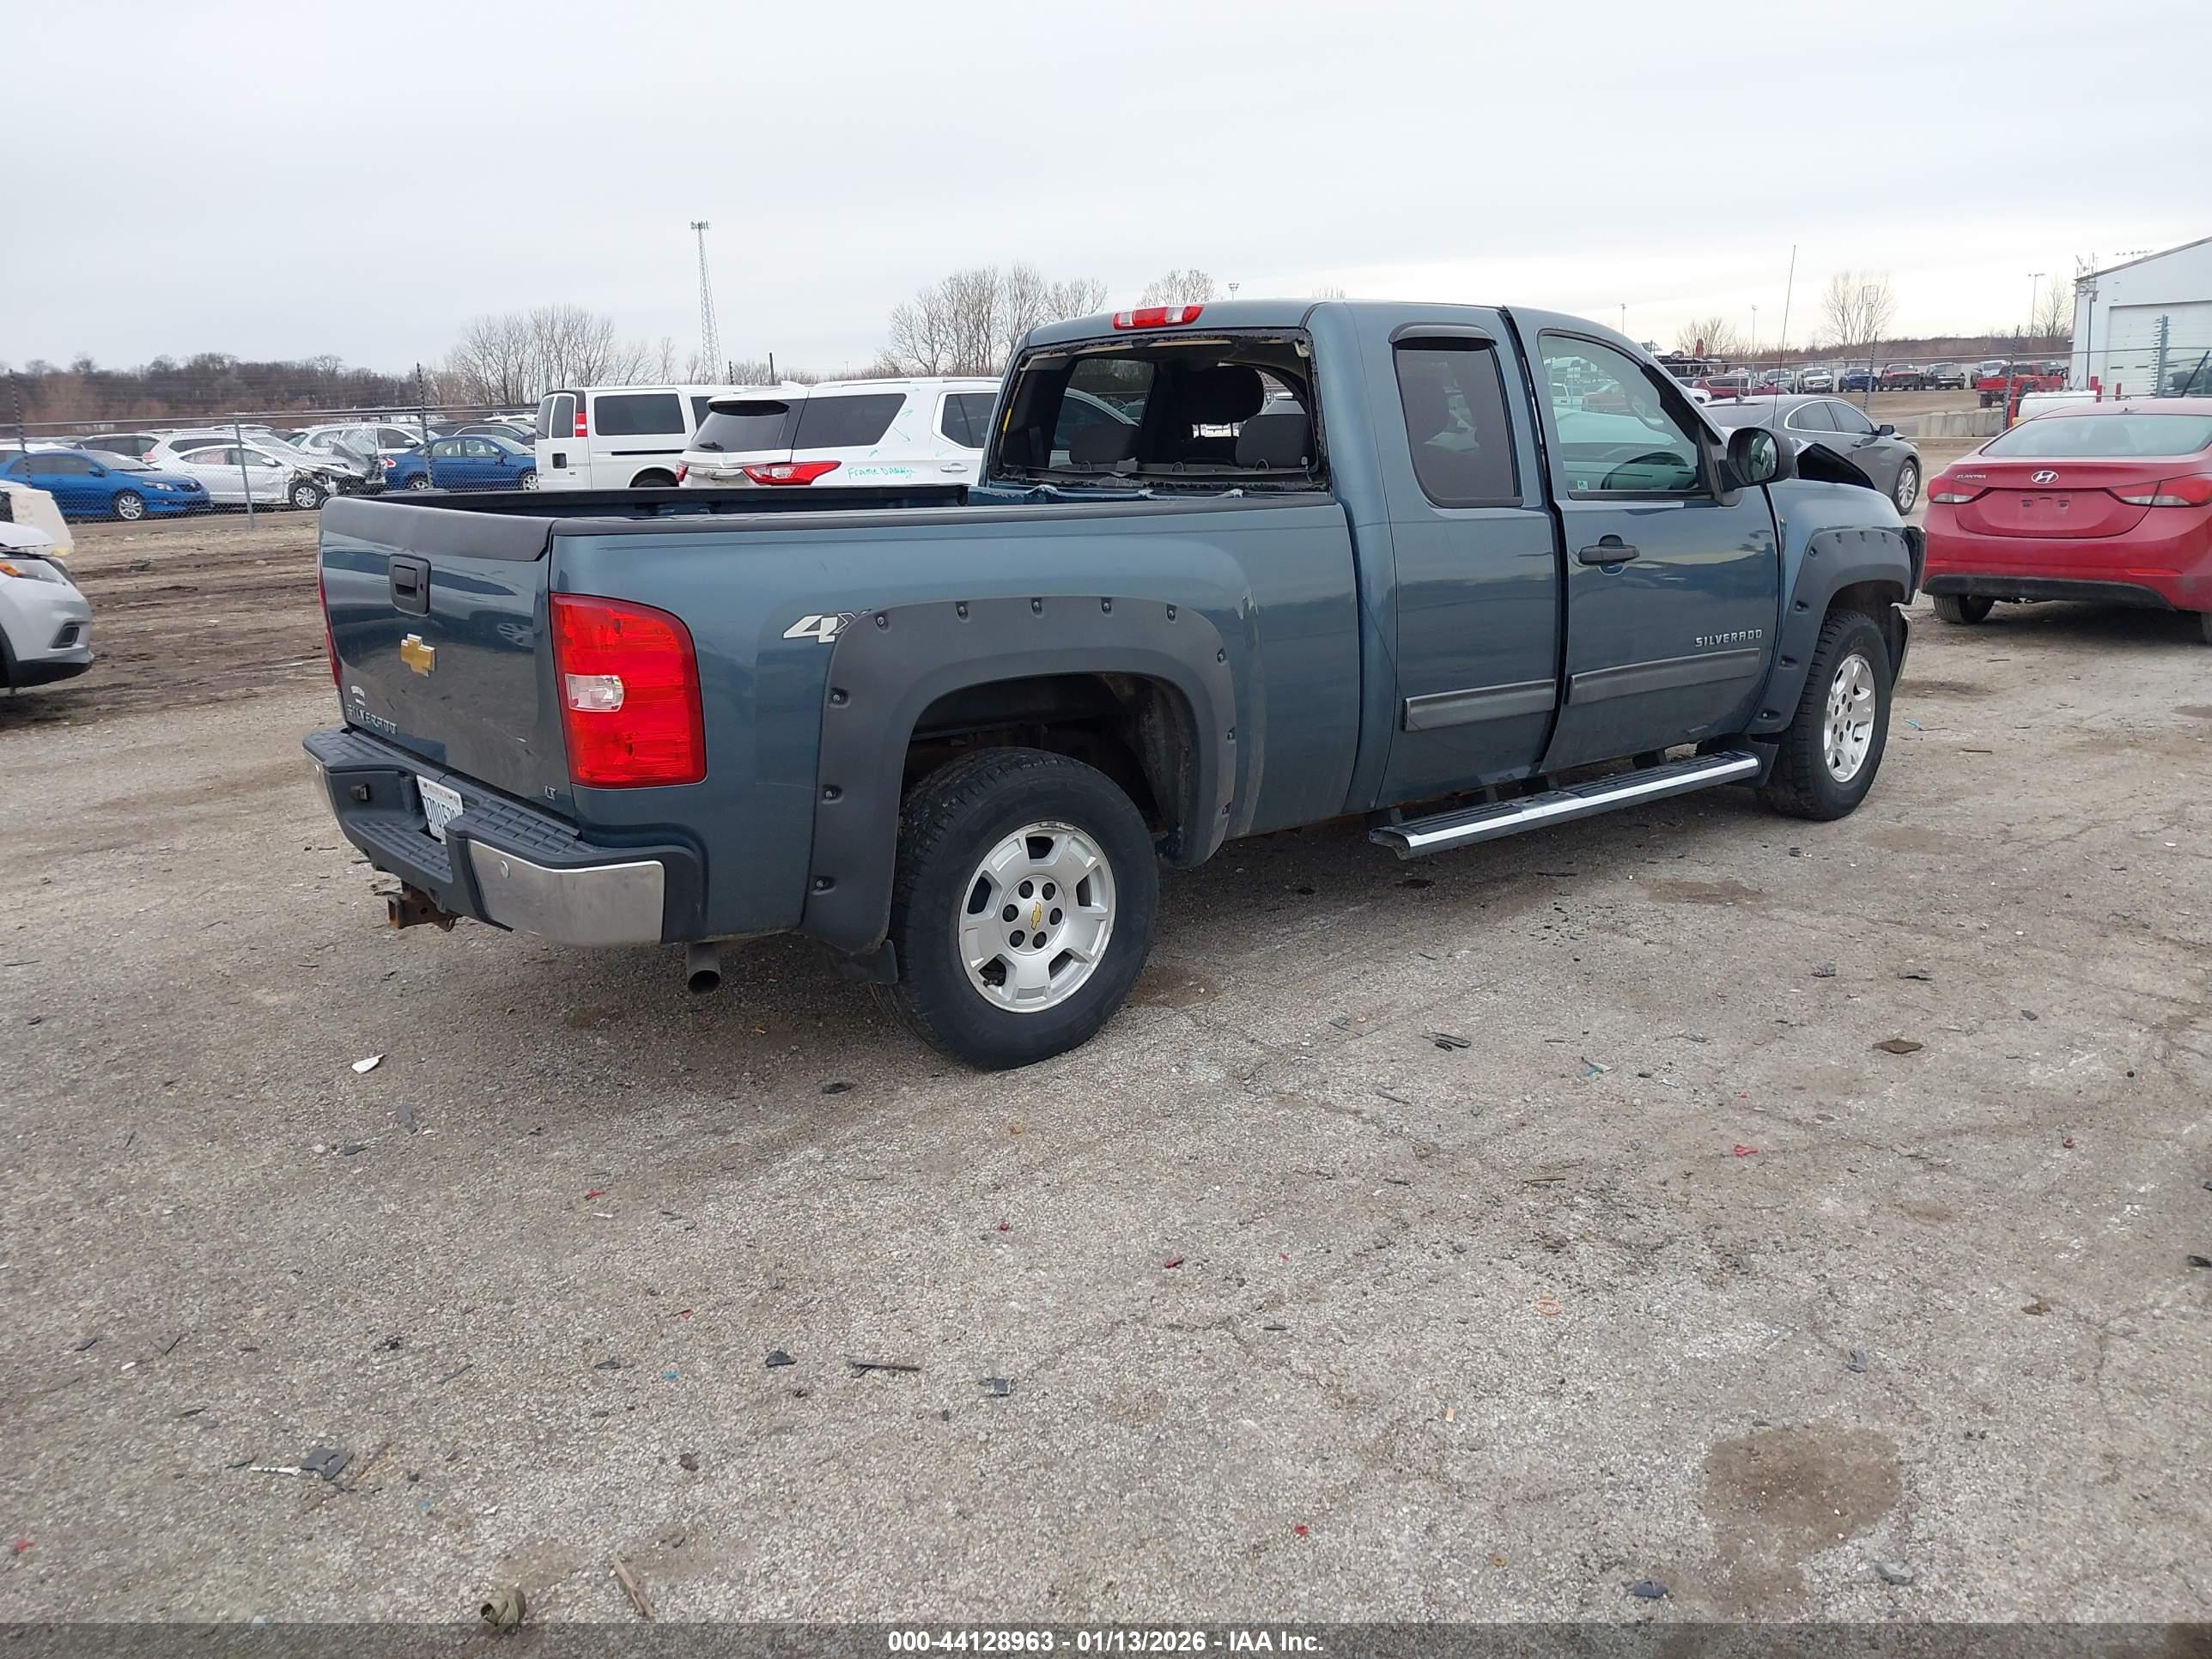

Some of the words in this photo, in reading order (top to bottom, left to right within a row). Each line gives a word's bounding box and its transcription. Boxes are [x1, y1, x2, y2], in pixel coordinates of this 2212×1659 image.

[1695, 629, 1762, 647] SILVERADO
[346, 703, 398, 736] SILVERADO
[544, 785, 556, 800] LT
